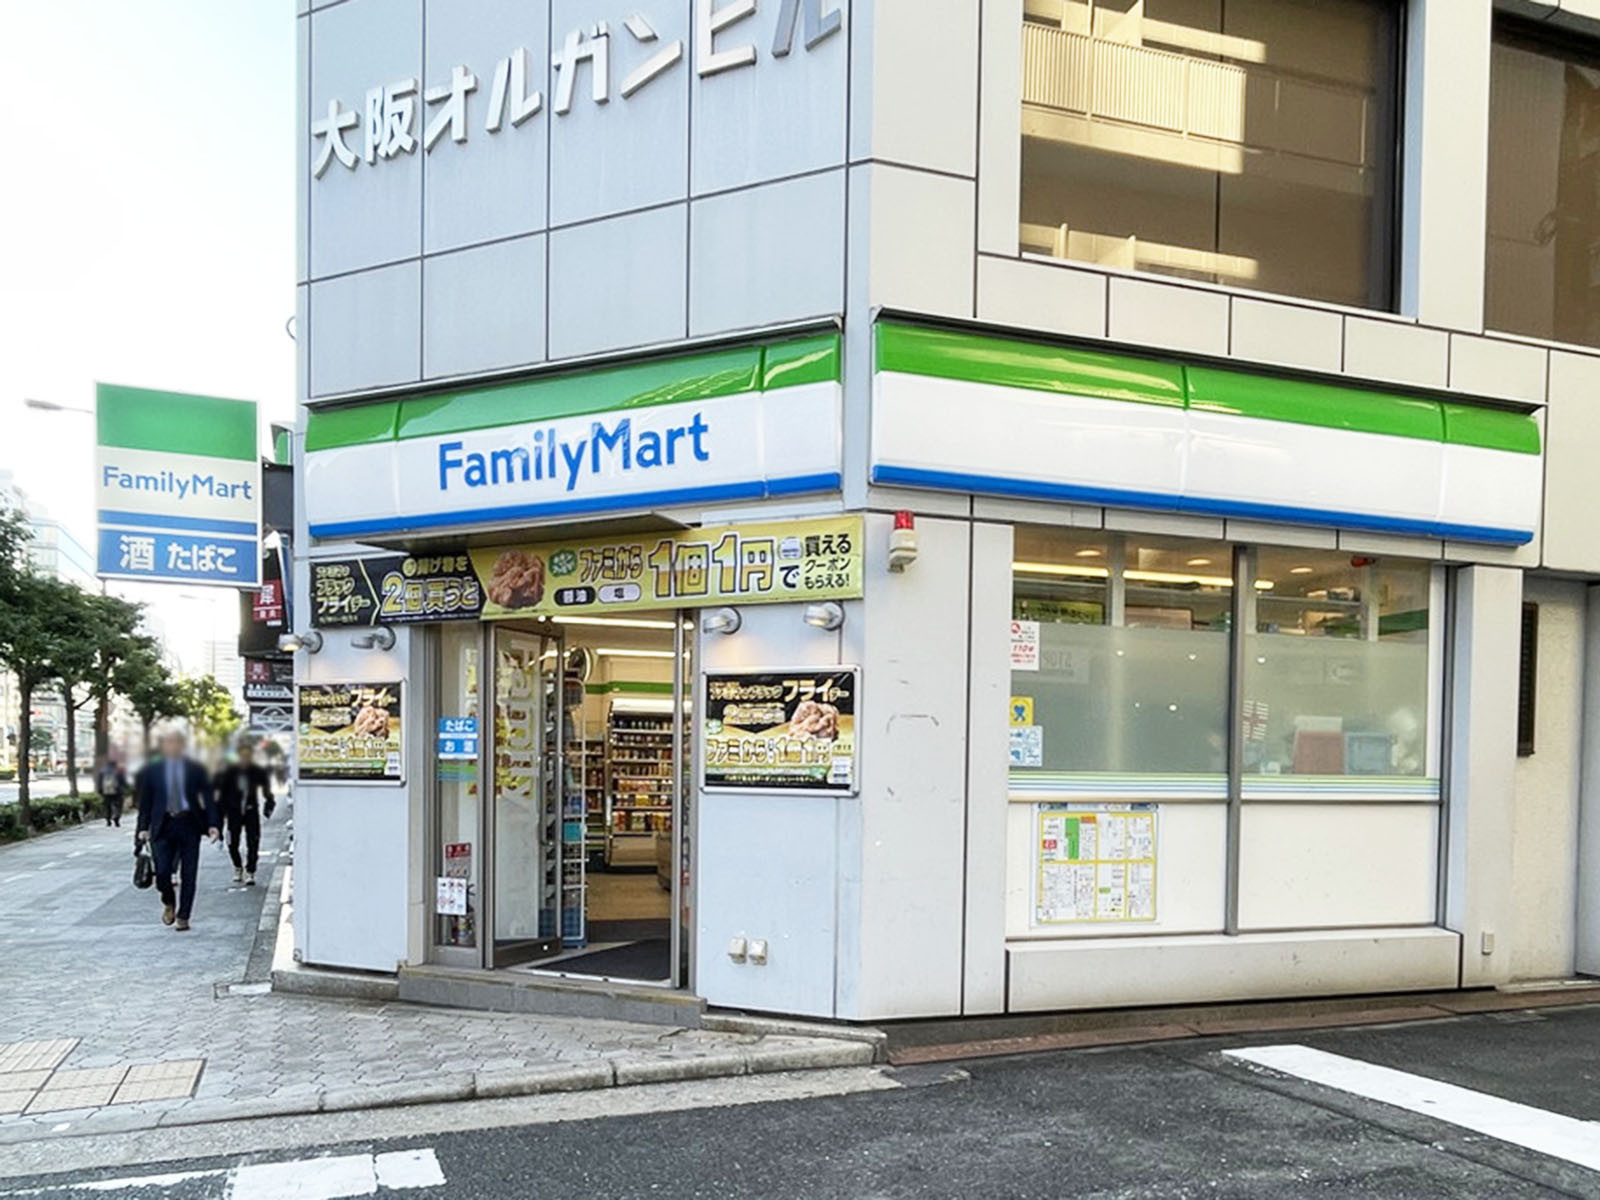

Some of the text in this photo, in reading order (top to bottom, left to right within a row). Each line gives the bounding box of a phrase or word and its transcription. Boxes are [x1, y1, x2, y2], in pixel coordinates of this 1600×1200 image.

[438, 411, 710, 492] FamilyMart
[103, 465, 252, 500] FamilyMart
[119, 535, 238, 574] 酒 たばこ
[804, 532, 852, 558] 買える
[804, 555, 852, 574] クーポン
[804, 573, 850, 590] もらえる!
